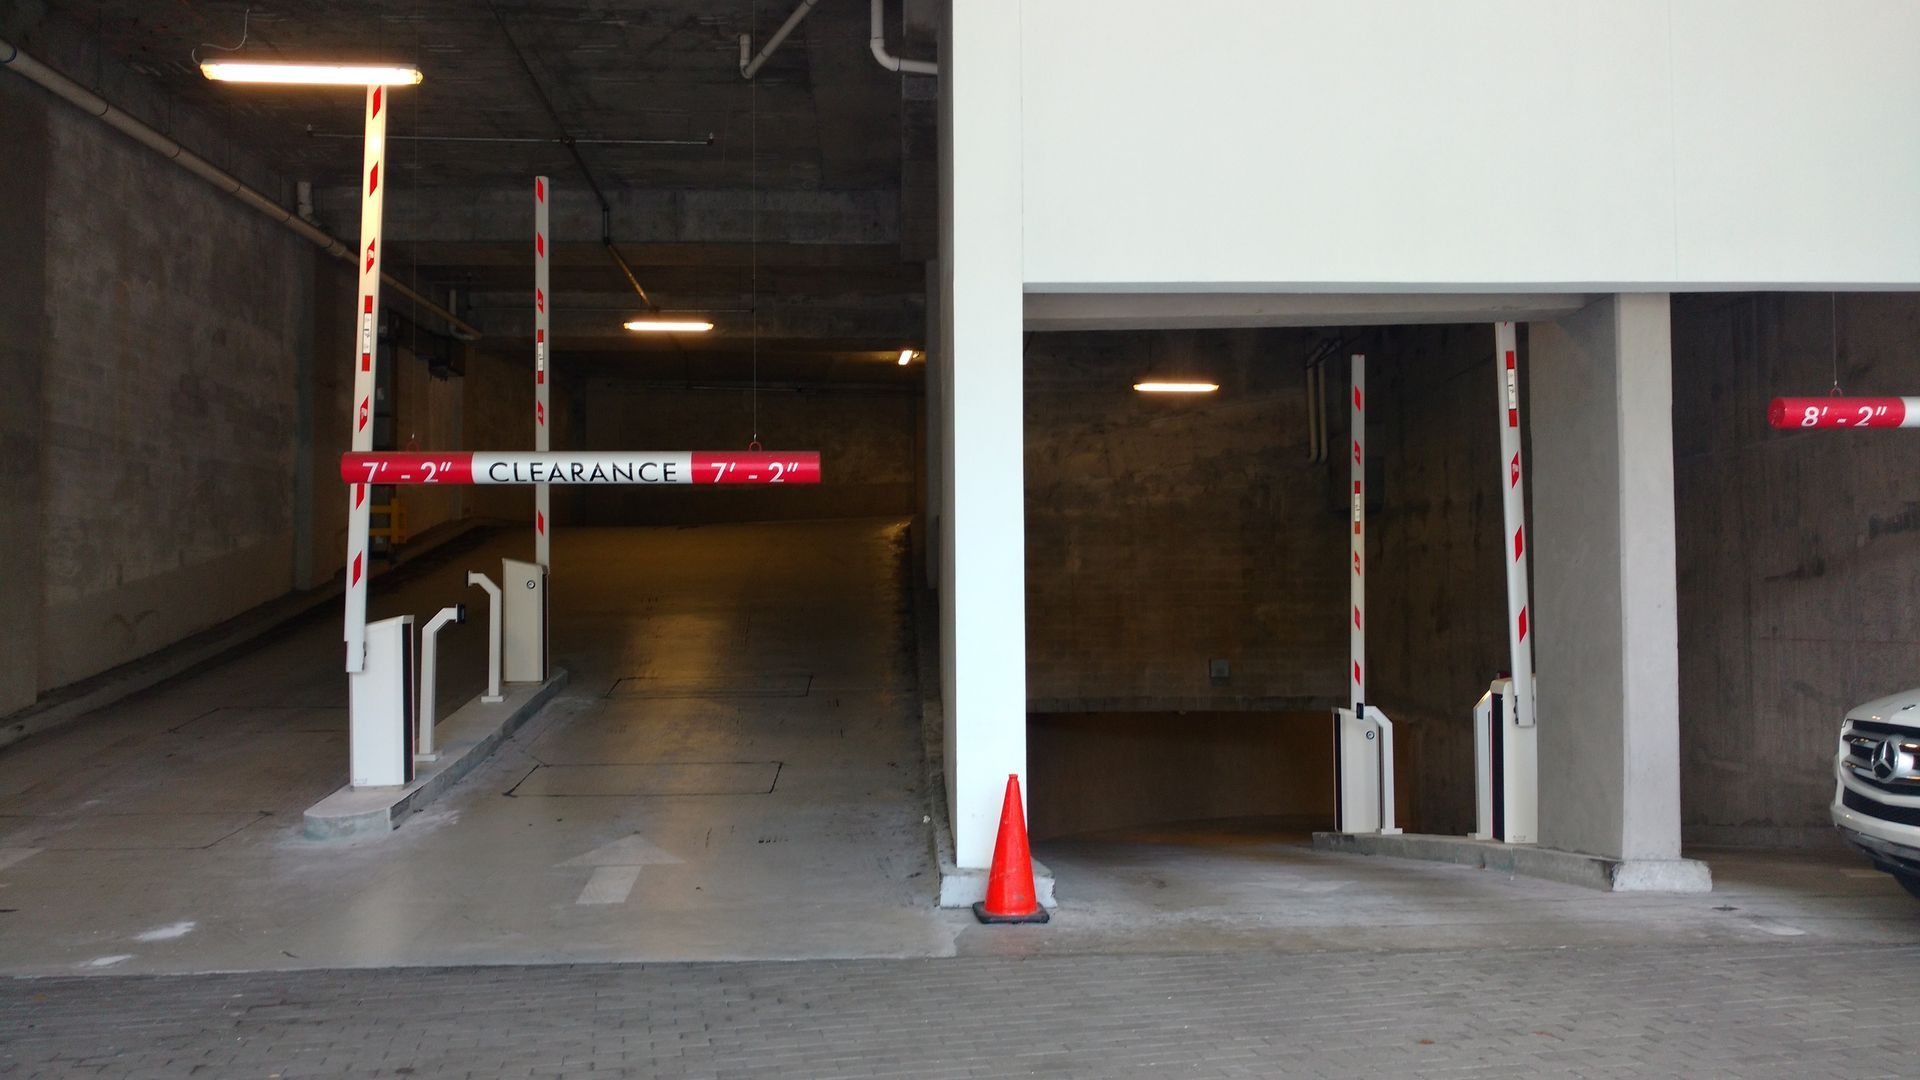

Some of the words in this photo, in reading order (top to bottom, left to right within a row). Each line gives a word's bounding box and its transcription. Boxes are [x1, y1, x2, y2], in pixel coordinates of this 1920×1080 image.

[1801, 406, 1829, 427] 8'
[1854, 405, 1888, 427] 2"
[362, 461, 388, 483] 7'
[420, 461, 452, 483] 2"
[488, 462, 677, 482] CLEARANCE
[710, 462, 736, 483] 7'
[768, 461, 799, 483] 2"
